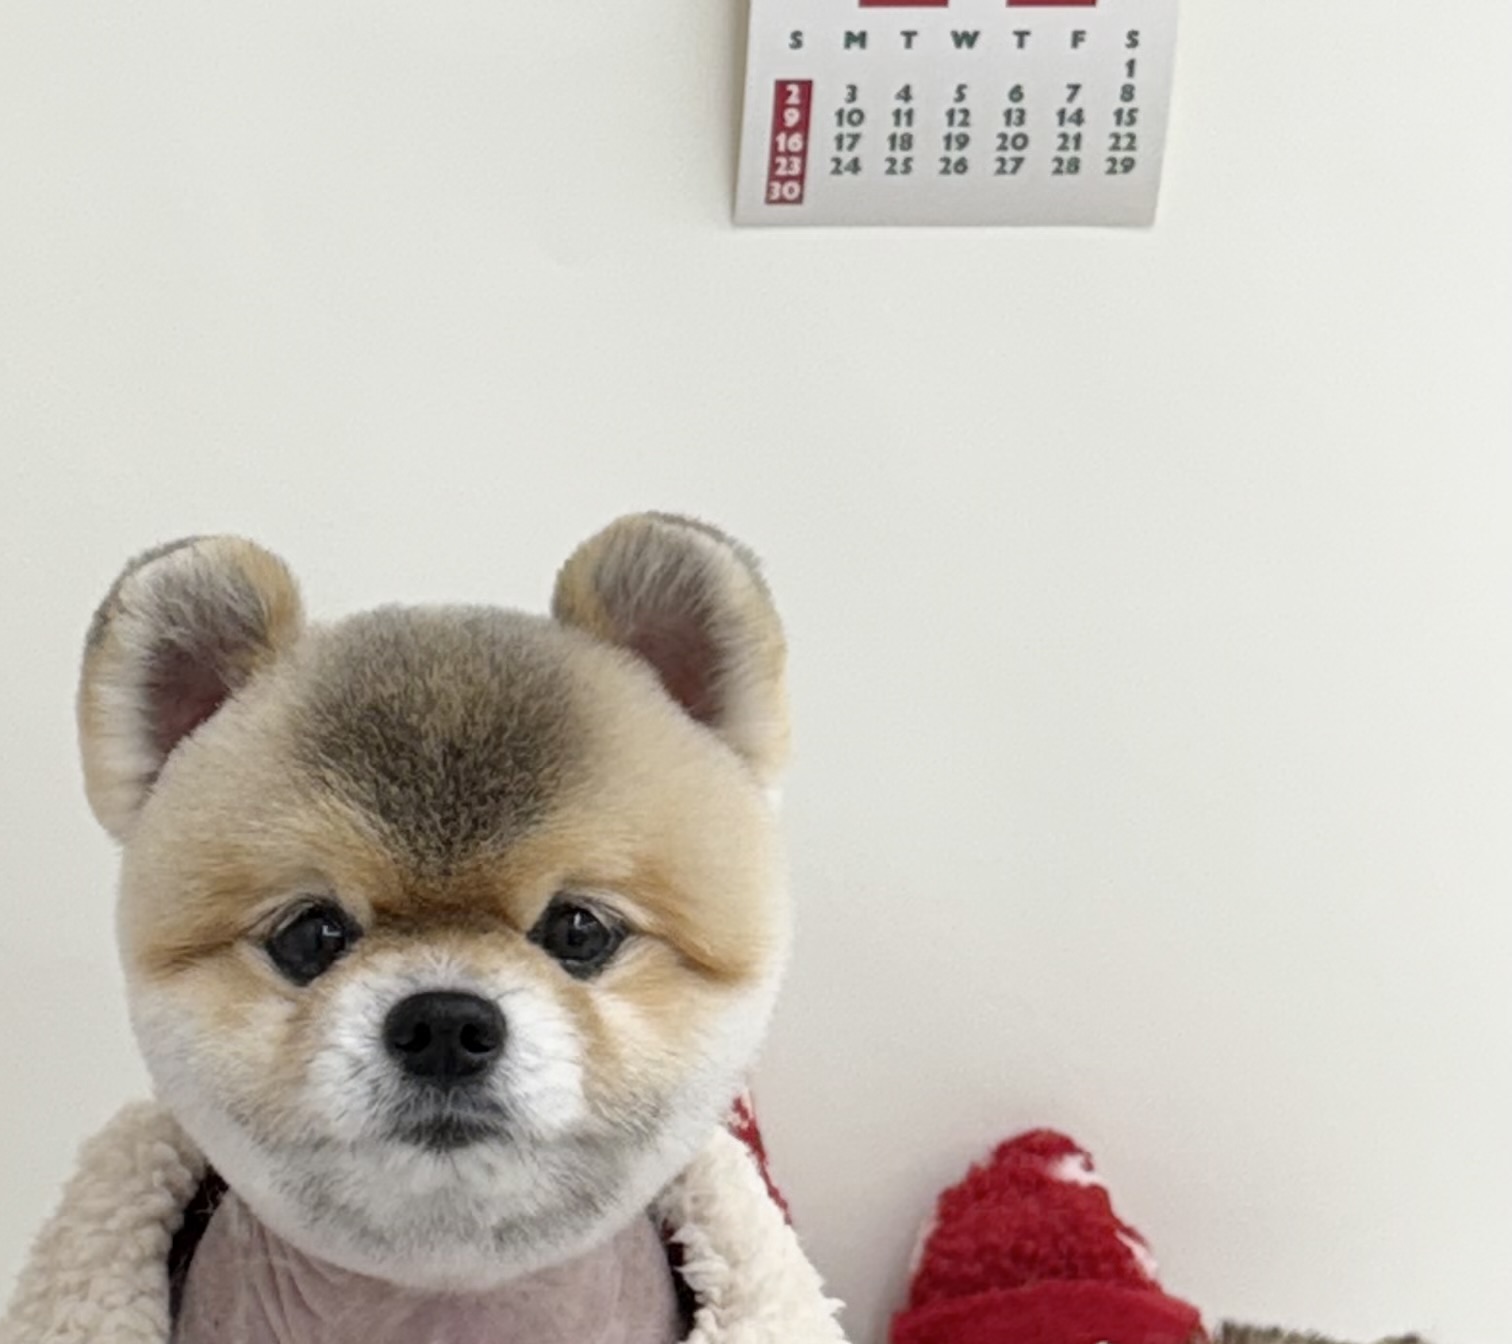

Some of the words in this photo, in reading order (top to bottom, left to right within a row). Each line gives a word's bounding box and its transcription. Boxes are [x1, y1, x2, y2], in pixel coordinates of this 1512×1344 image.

[789, 30, 804, 50] S
[843, 30, 868, 50] M
[900, 30, 919, 50] T
[950, 30, 981, 49] W
[1012, 29, 1032, 49] T
[1070, 29, 1087, 49] F
[1125, 29, 1140, 49] S
[1125, 58, 1136, 79] 1
[786, 83, 801, 105] 2
[845, 84, 858, 104] 3
[895, 84, 913, 104] 4
[953, 83, 968, 104] 5
[1007, 83, 1025, 104] 6
[1066, 83, 1082, 104] 7
[1119, 83, 1136, 103] 8
[783, 107, 801, 128] 9
[835, 107, 866, 128] 10
[892, 107, 914, 128] 11
[945, 107, 971, 128] 12
[1003, 107, 1026, 127] 13
[1056, 107, 1085, 127] 14
[1113, 107, 1139, 127] 15
[775, 132, 804, 153] 16
[834, 132, 862, 152] 17
[887, 132, 914, 152] 18
[943, 132, 971, 152] 19
[996, 132, 1030, 152] 20
[1057, 131, 1083, 152] 21
[1108, 131, 1137, 152] 22
[775, 156, 802, 176] 23
[830, 156, 862, 176] 24
[884, 156, 914, 176] 25
[939, 156, 969, 176] 26
[994, 156, 1025, 176] 27
[1051, 156, 1081, 176] 28
[1105, 156, 1136, 176] 29
[769, 180, 801, 201] 30
